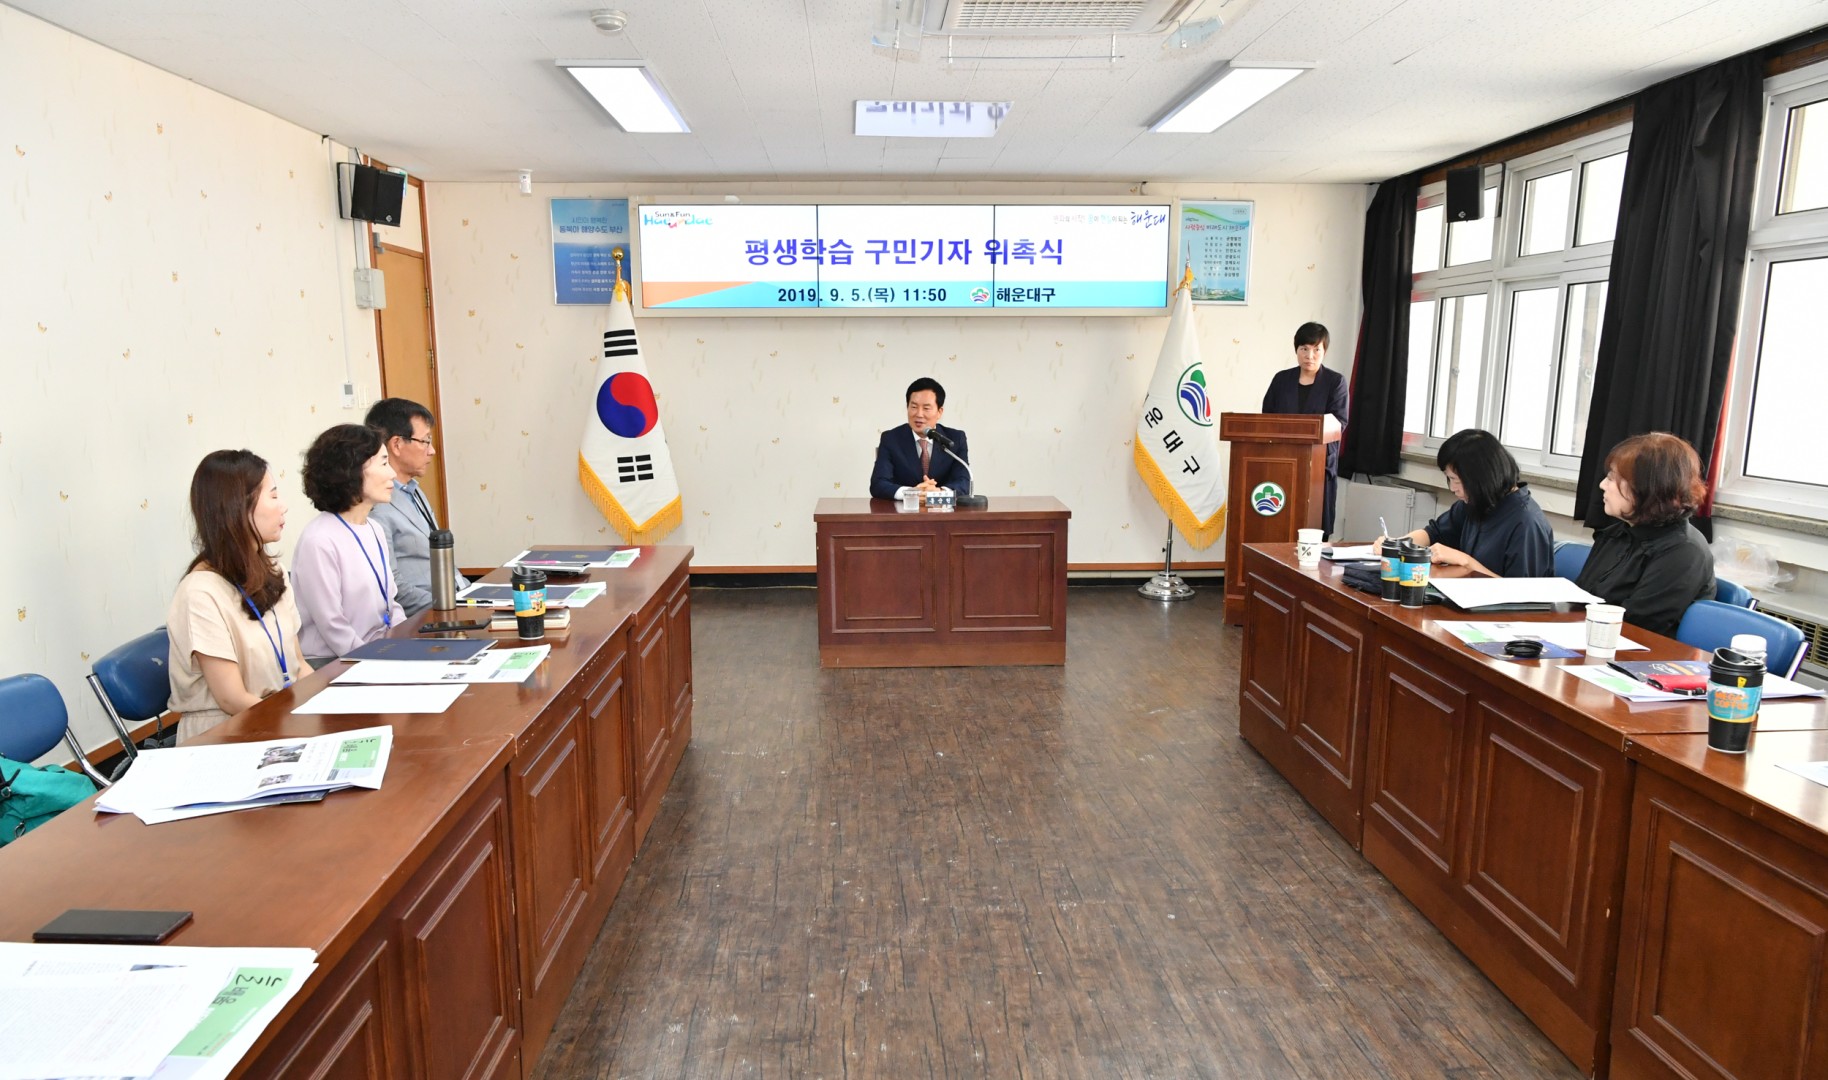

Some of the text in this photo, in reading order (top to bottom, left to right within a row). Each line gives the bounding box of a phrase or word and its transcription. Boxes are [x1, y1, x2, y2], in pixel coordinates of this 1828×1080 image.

[1131, 210, 1166, 228] 해운대
[559, 225, 623, 234] 동북아 해양수도 부산
[745, 239, 1063, 266] 평생학습 구민기자 위촉식
[778, 287, 947, 303] 2019. 9. 5.(목) 11:50
[996, 287, 1056, 302] 해운대구
